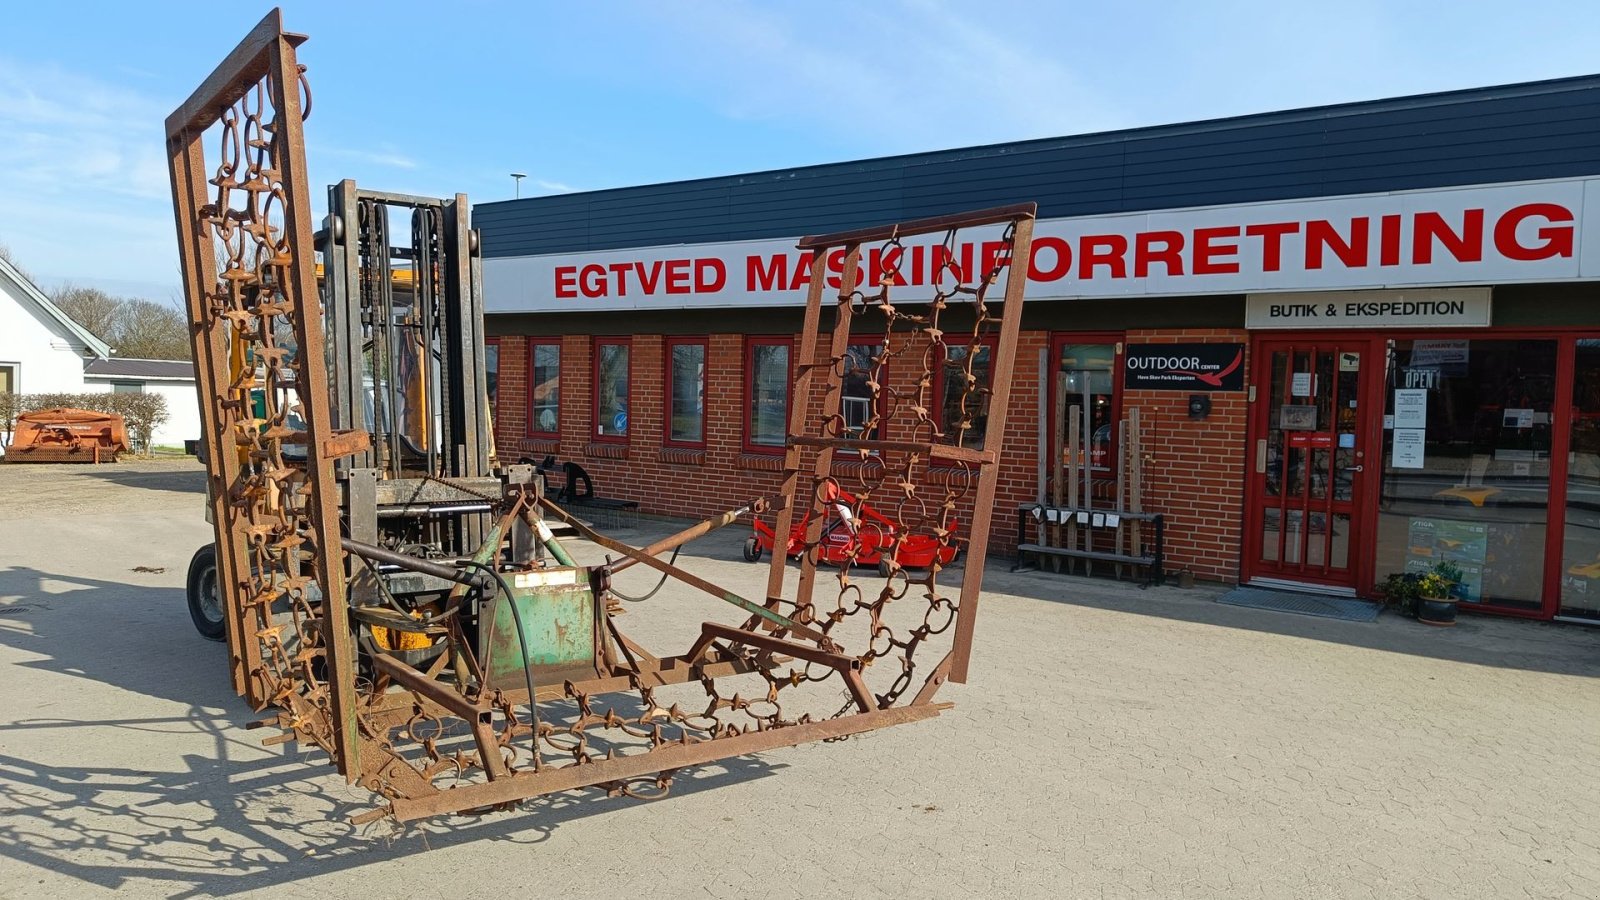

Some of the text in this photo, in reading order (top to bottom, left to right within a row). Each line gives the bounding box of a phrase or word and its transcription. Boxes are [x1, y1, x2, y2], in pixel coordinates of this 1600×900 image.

[555, 203, 1574, 298] EGTVED MASKINFORRETNING
[1269, 300, 1465, 318] BUTIK & EKSPEDITION
[1127, 356, 1200, 370] OUTDOOR
[1405, 372, 1433, 389] OPEN
